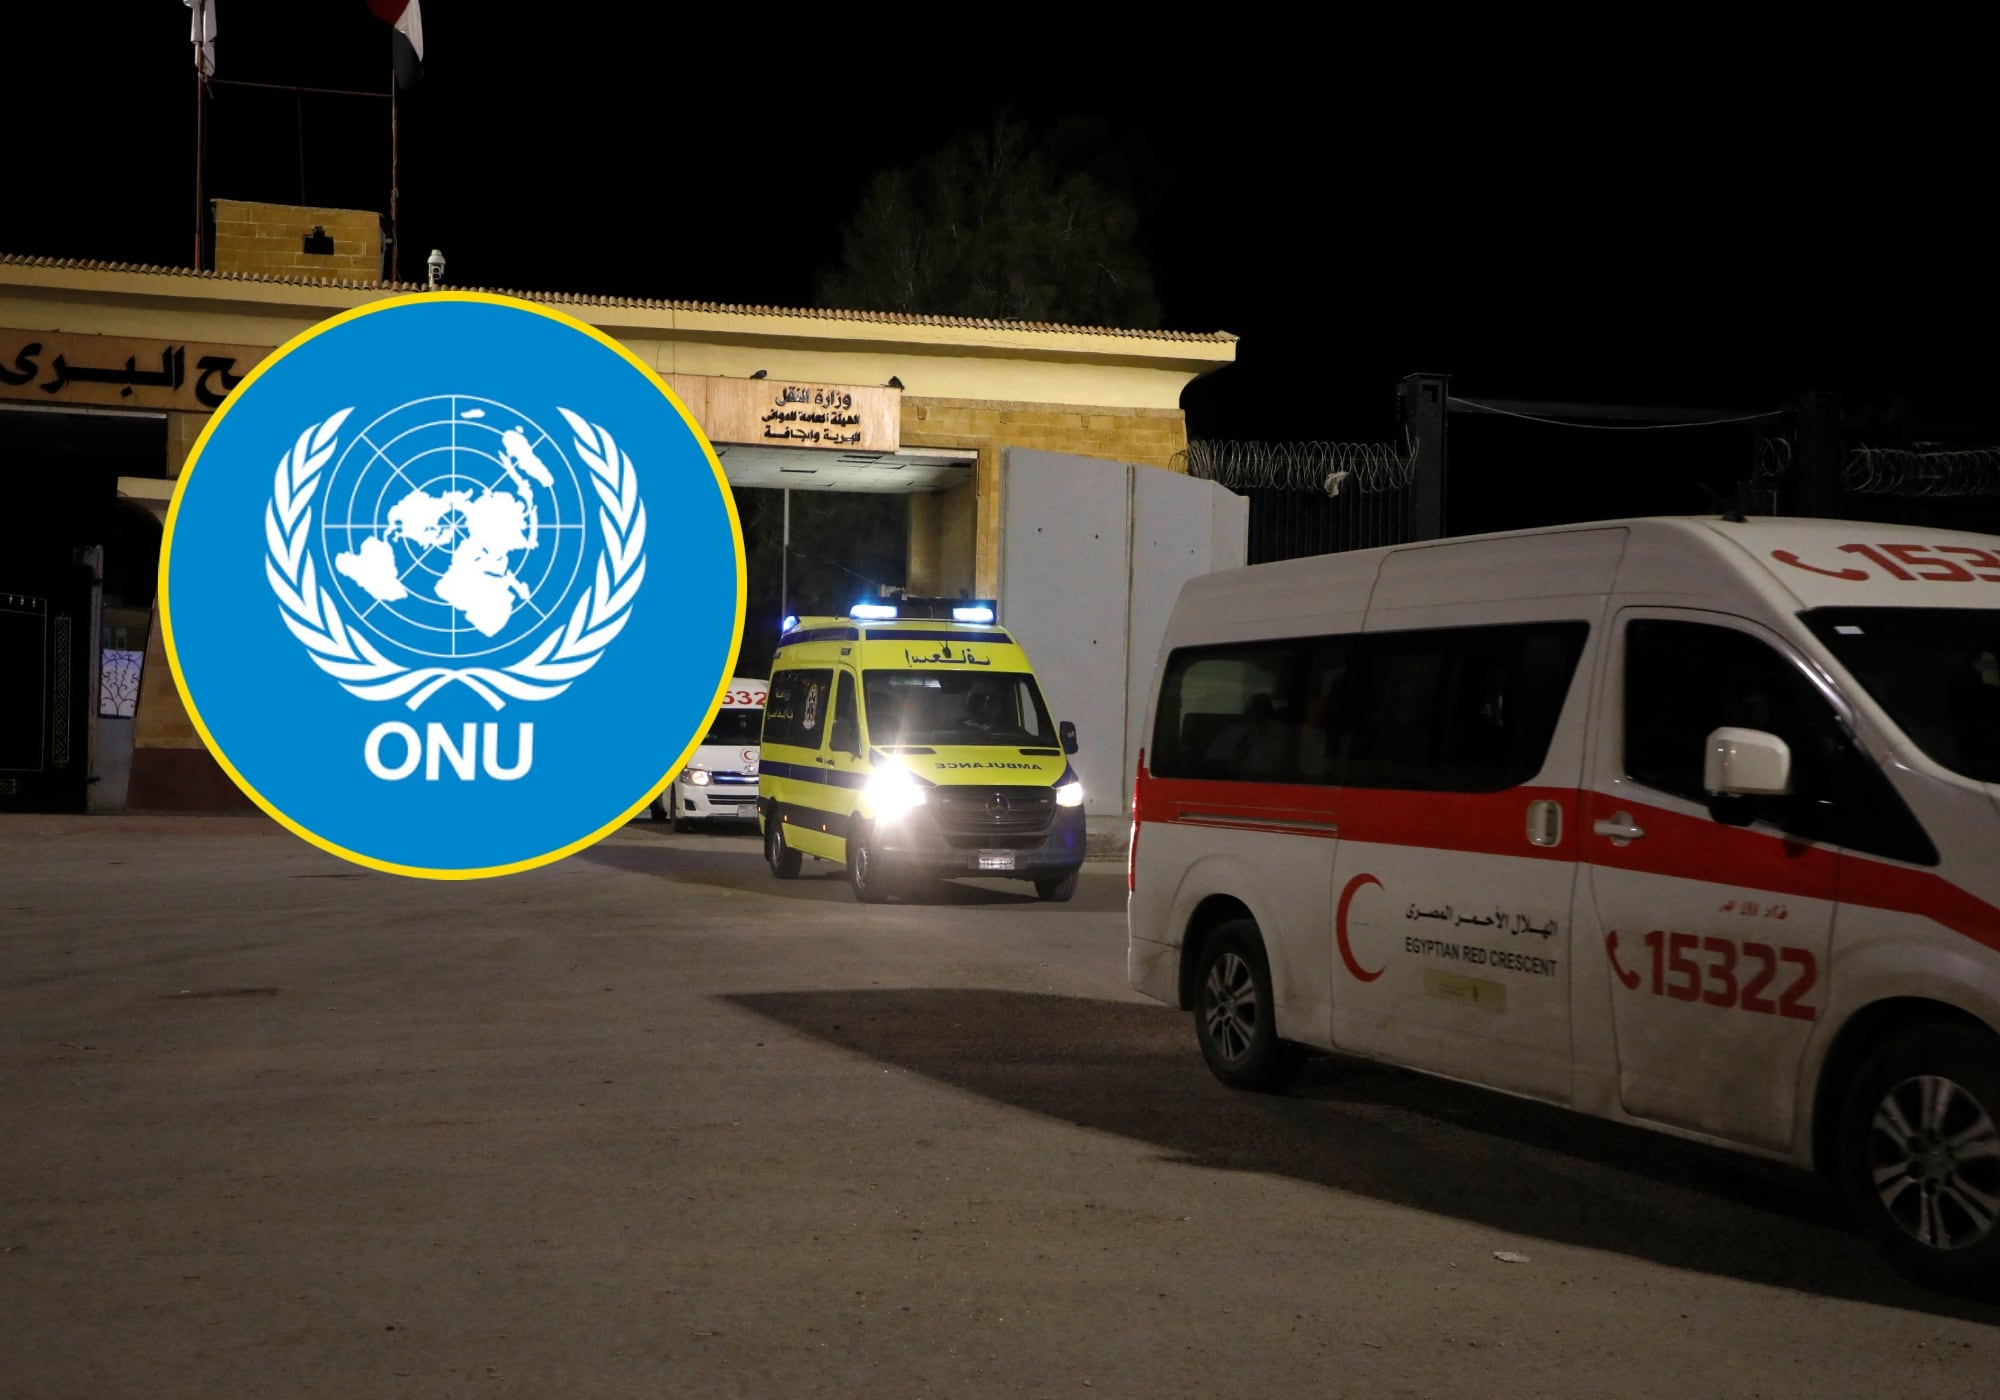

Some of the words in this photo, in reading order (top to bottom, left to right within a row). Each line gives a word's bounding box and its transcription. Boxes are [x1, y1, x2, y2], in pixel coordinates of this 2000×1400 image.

[0, 342, 185, 397] البرى
[775, 386, 809, 407] النقل
[814, 388, 852, 410] وزارة
[798, 411, 830, 423] العامة
[830, 411, 861, 427] الهيئة
[764, 424, 820, 443] والجافة
[1837, 543, 2000, 583] 153
[1511, 912, 1558, 940] الهلال
[1404, 936, 1460, 961] EGYPTIAN
[1463, 945, 1488, 965] RED
[1490, 951, 1558, 977] CRESCENT
[1643, 929, 1818, 1022] 15322
